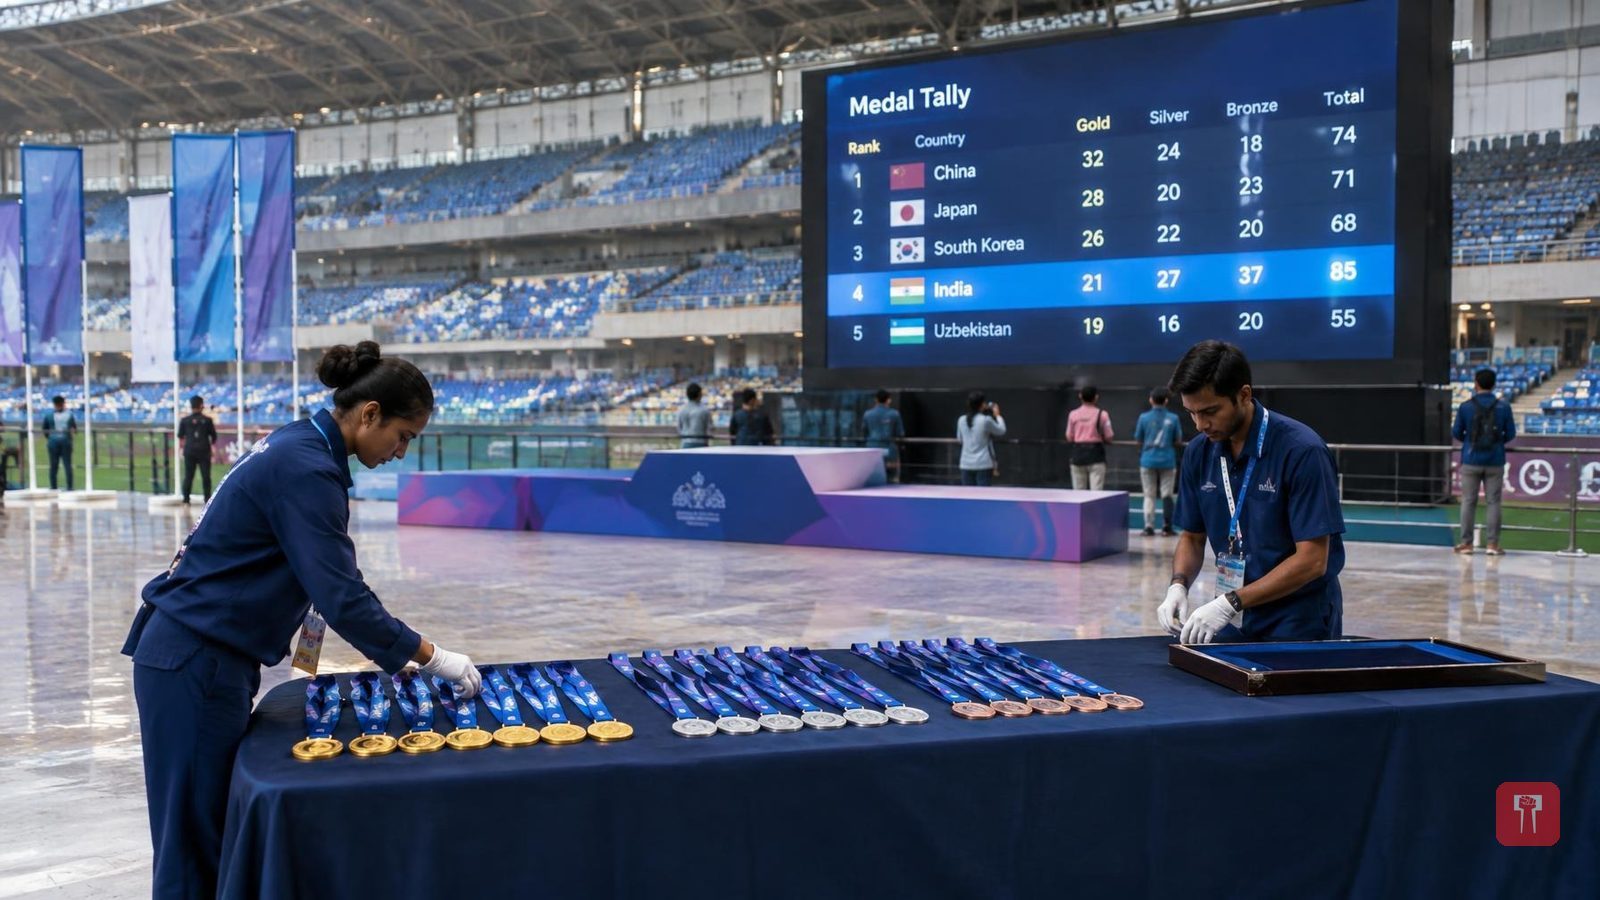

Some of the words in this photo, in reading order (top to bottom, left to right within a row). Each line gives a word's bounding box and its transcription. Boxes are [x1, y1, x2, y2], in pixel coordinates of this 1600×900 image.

[848, 139, 881, 154] Rank
[914, 133, 966, 148] Country
[1076, 115, 1111, 132] Gold
[1149, 110, 1190, 124] Silver
[1226, 101, 1279, 118] Bronze
[1323, 88, 1365, 105] Total
[849, 89, 915, 116] Medal
[919, 84, 972, 109] Tally
[852, 170, 863, 188] 1
[933, 164, 977, 180] China
[1082, 150, 1104, 167] 32
[1157, 142, 1181, 161] 24
[1240, 135, 1263, 154] 18
[1331, 126, 1357, 145] 74
[852, 209, 863, 225] 2
[933, 203, 978, 220] Japan
[1081, 189, 1105, 207] 28
[1157, 183, 1181, 201] 20
[1239, 175, 1263, 195] 23
[1331, 169, 1354, 188] 71
[853, 245, 863, 261] 3
[934, 239, 978, 255] South
[981, 238, 1025, 252] Korea
[1081, 230, 1105, 247] 26
[1157, 224, 1181, 242] 22
[1239, 219, 1264, 237] 20
[1330, 213, 1357, 232] 68
[852, 285, 864, 301] 4
[933, 281, 974, 297] India
[1082, 274, 1102, 291] 21
[1156, 270, 1181, 288] 27
[1238, 265, 1264, 284] 37
[1329, 261, 1357, 281] 85
[853, 325, 863, 340] 5
[934, 322, 1012, 338] Uzbekistan
[1083, 318, 1104, 334] 19
[1158, 315, 1181, 332] 16
[1238, 312, 1264, 330] 20
[1330, 309, 1357, 327] 55
